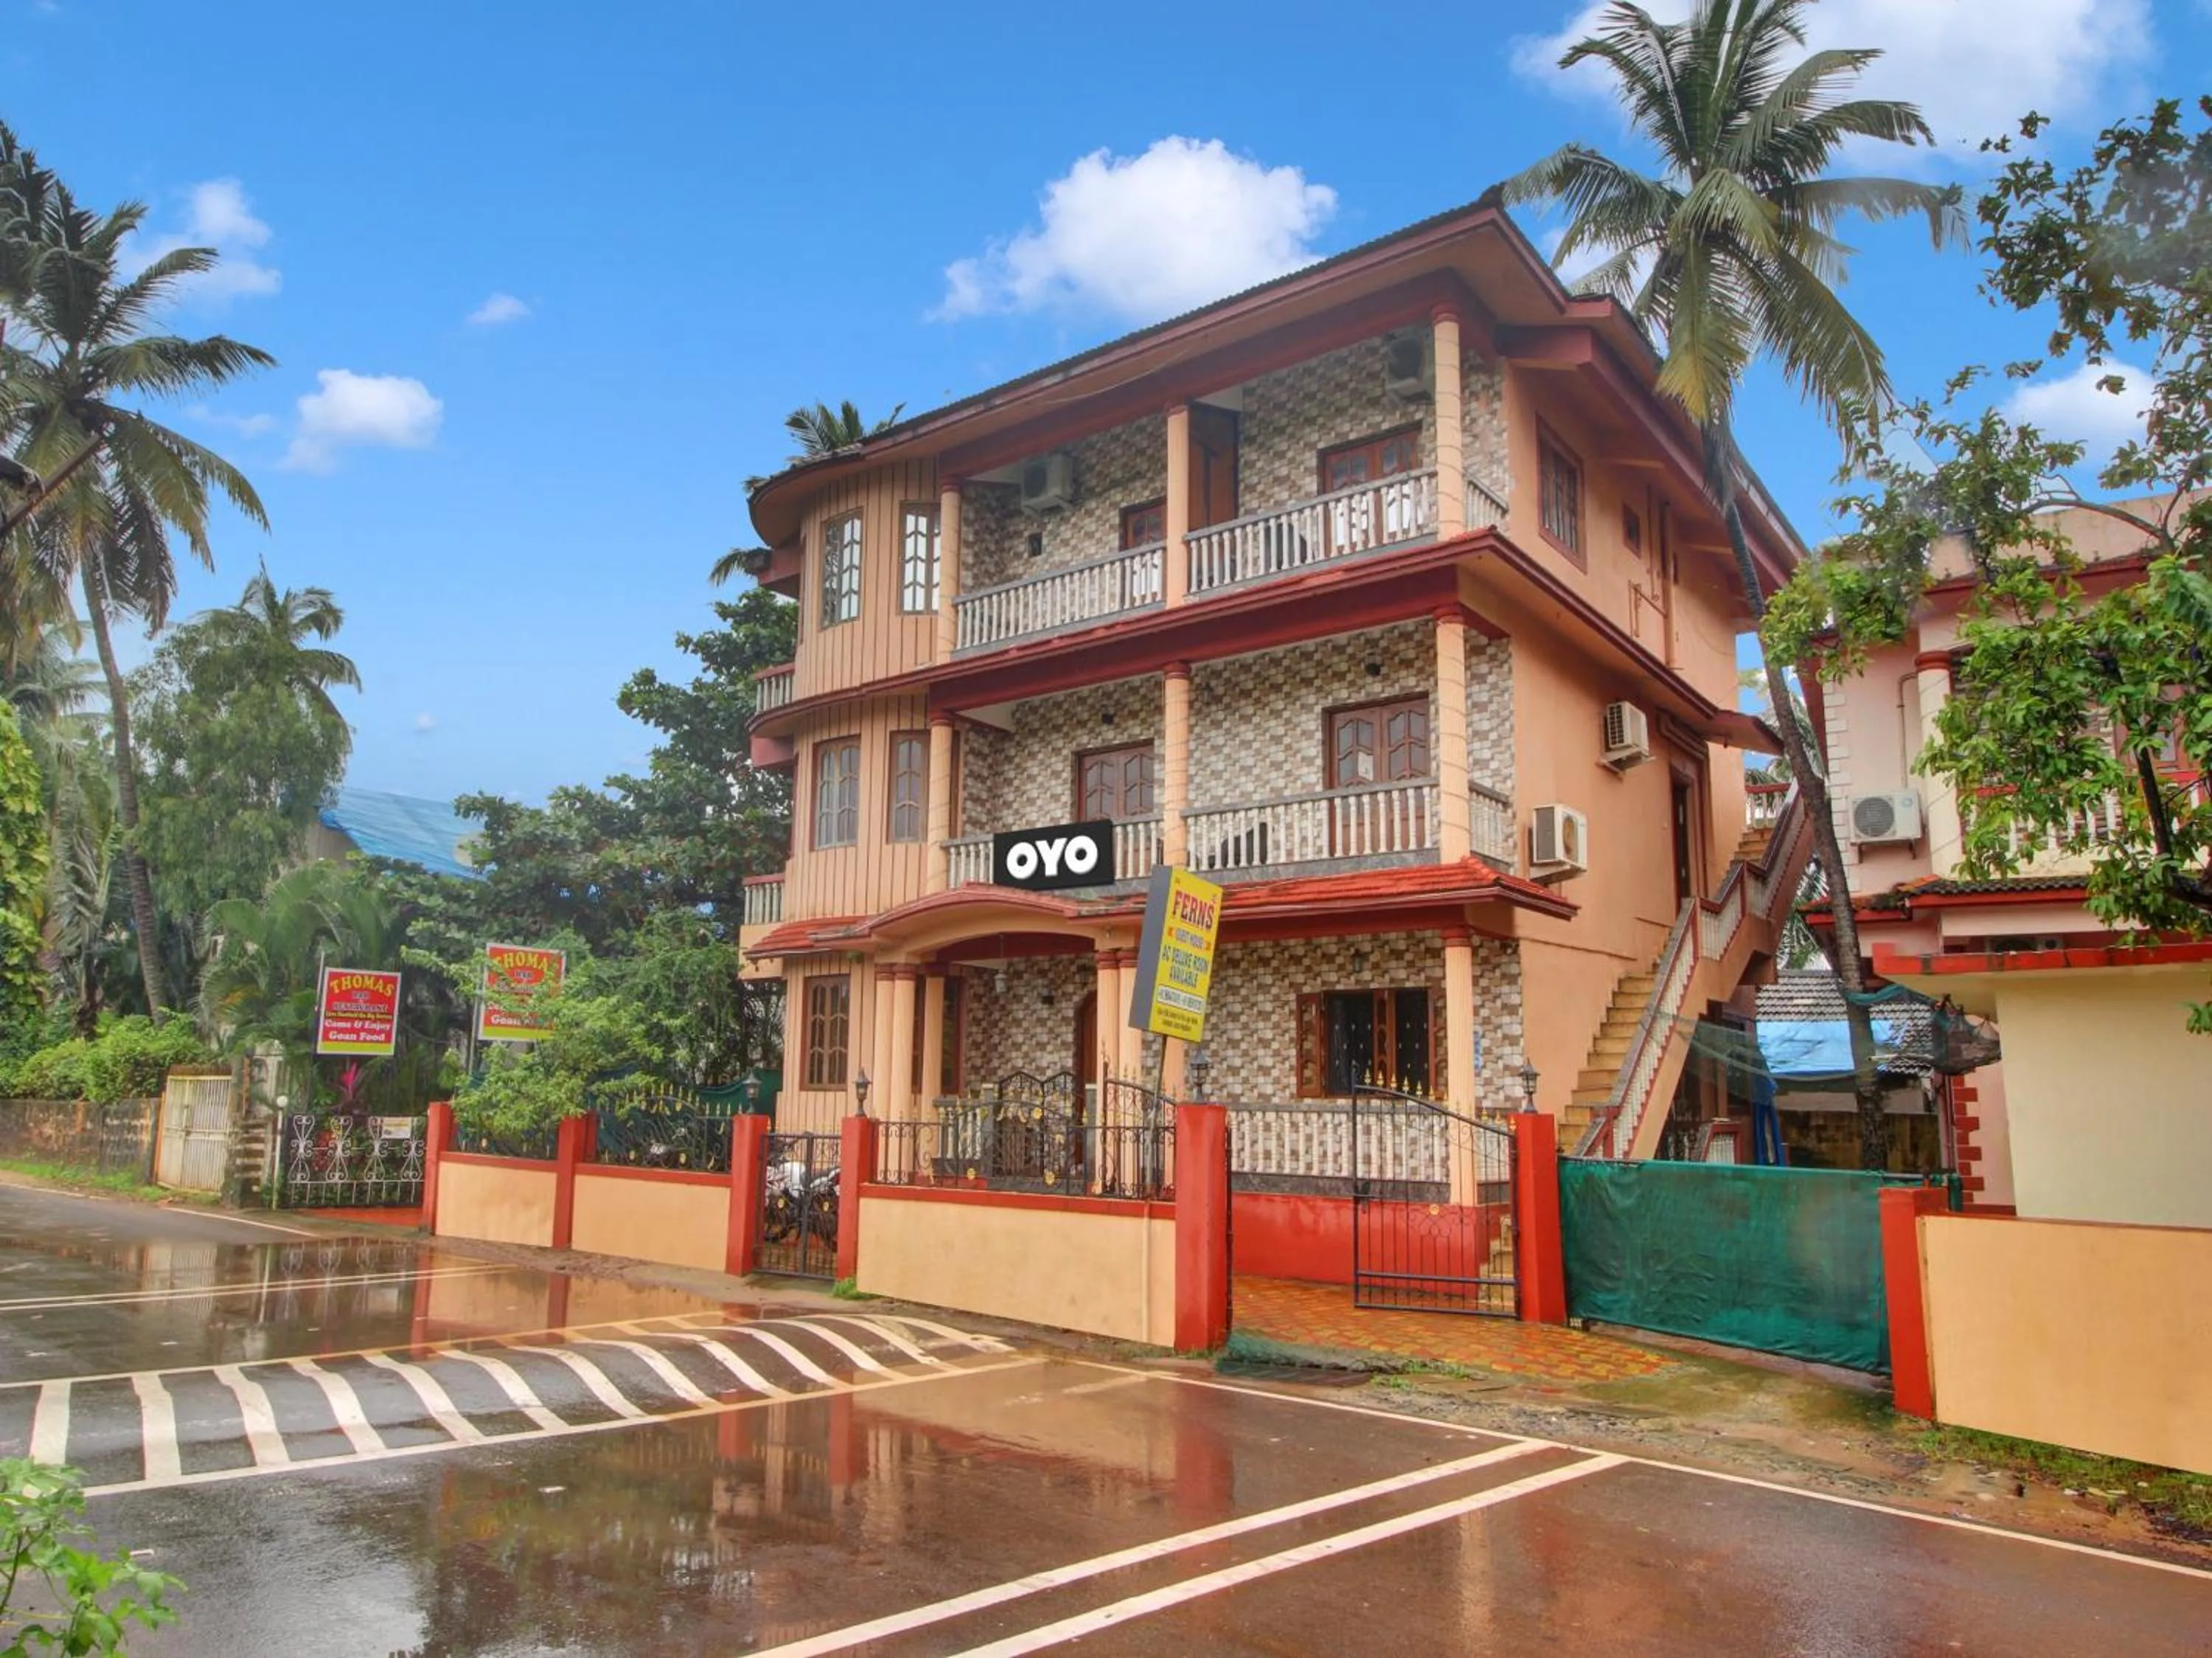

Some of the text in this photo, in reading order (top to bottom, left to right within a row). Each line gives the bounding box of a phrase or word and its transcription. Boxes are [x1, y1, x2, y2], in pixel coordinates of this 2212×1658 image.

[1006, 835, 1098, 880] OYO
[1172, 889, 1214, 930] FERNS
[492, 951, 558, 975] HOMA
[330, 974, 394, 997] THOMAS
[1169, 965, 1198, 988] AVAILABLE
[331, 1002, 389, 1013] RESTAURANT
[324, 1019, 352, 1028] Come
[364, 1021, 391, 1030] Enjoy
[329, 1031, 386, 1041] Goan Food
